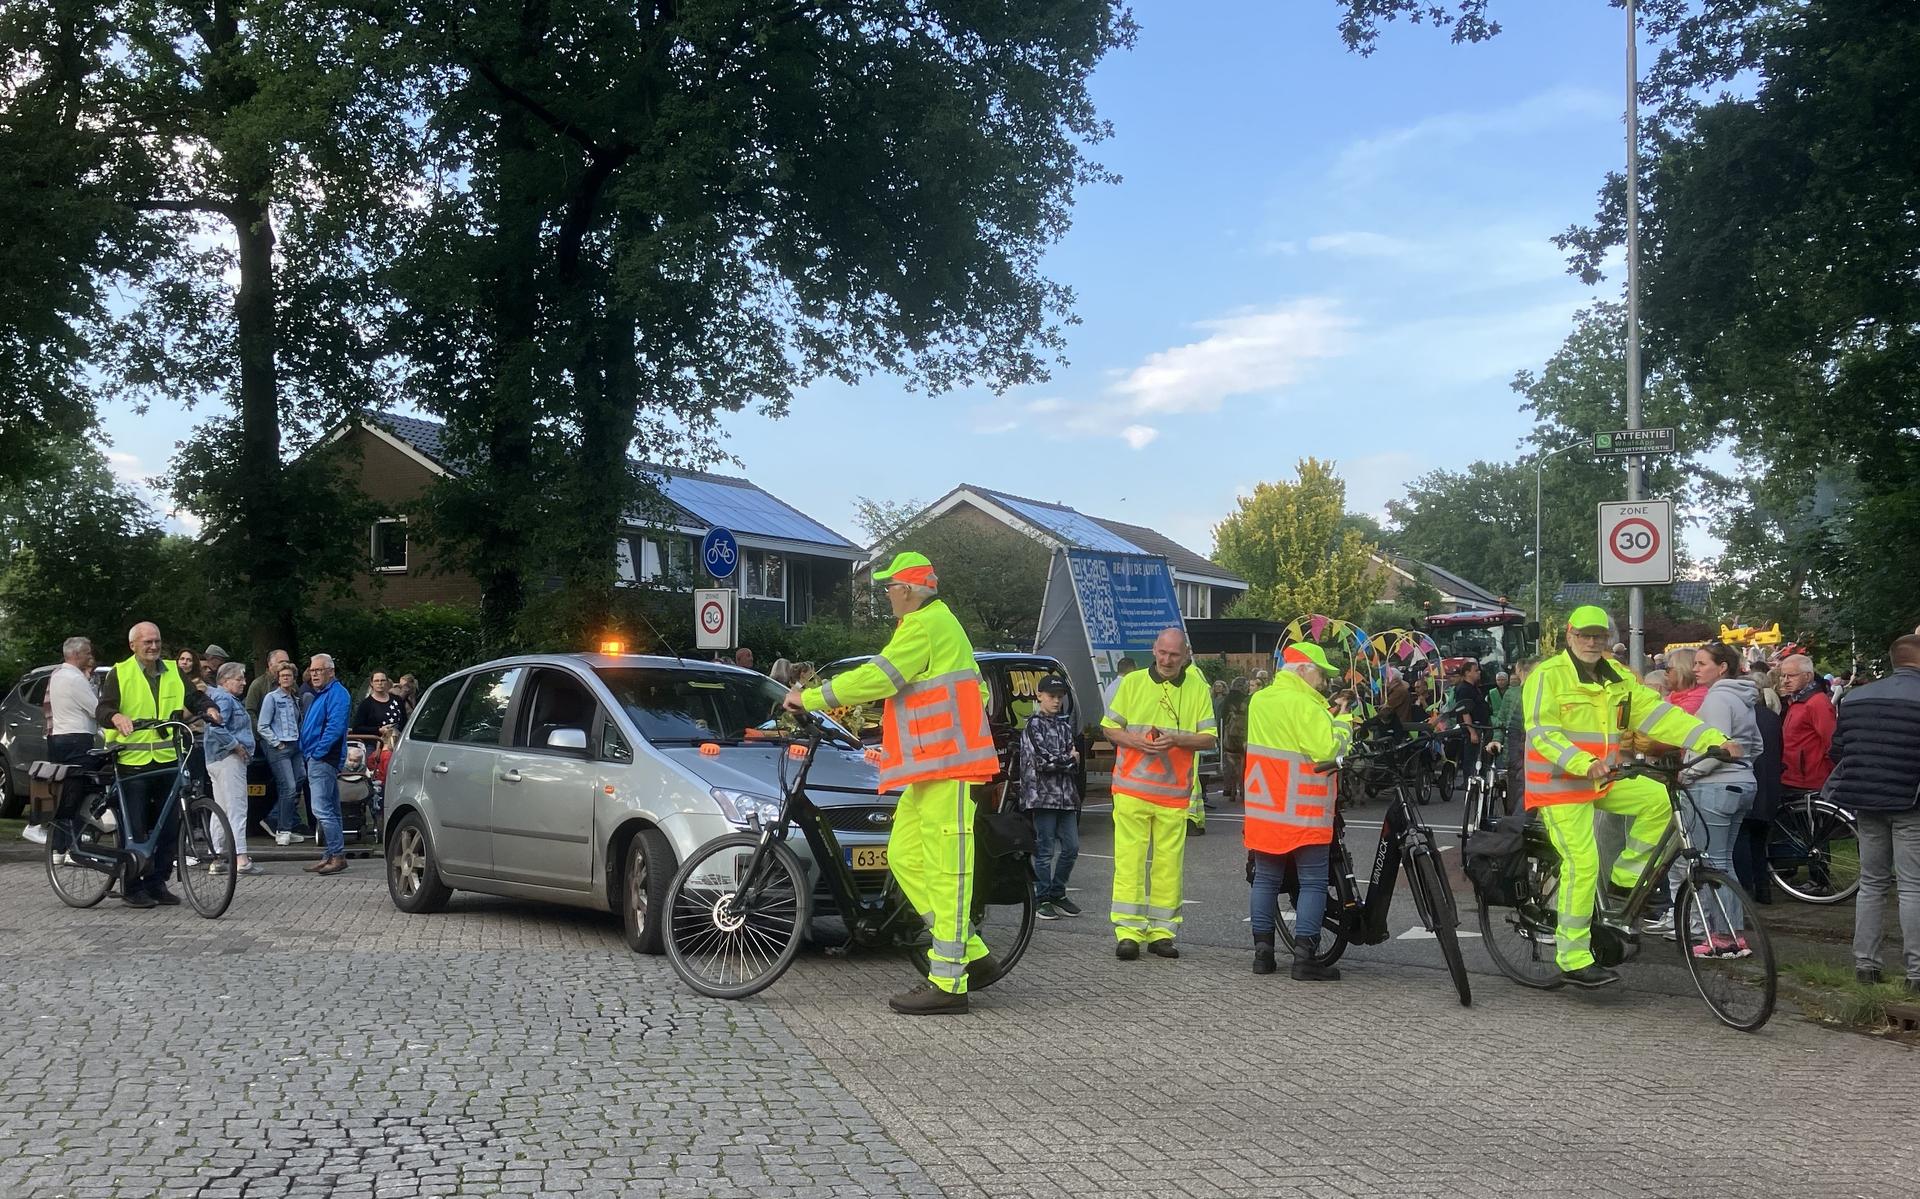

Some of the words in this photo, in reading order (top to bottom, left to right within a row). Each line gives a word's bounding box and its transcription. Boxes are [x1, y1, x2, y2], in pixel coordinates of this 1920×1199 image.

[1615, 430, 1670, 440] ATTENTIE!
[1620, 507, 1649, 515] ZONE
[1620, 532, 1651, 549] 30
[1134, 563, 1143, 576] DE
[705, 611, 720, 624] 30
[857, 850, 888, 867] 63-S
